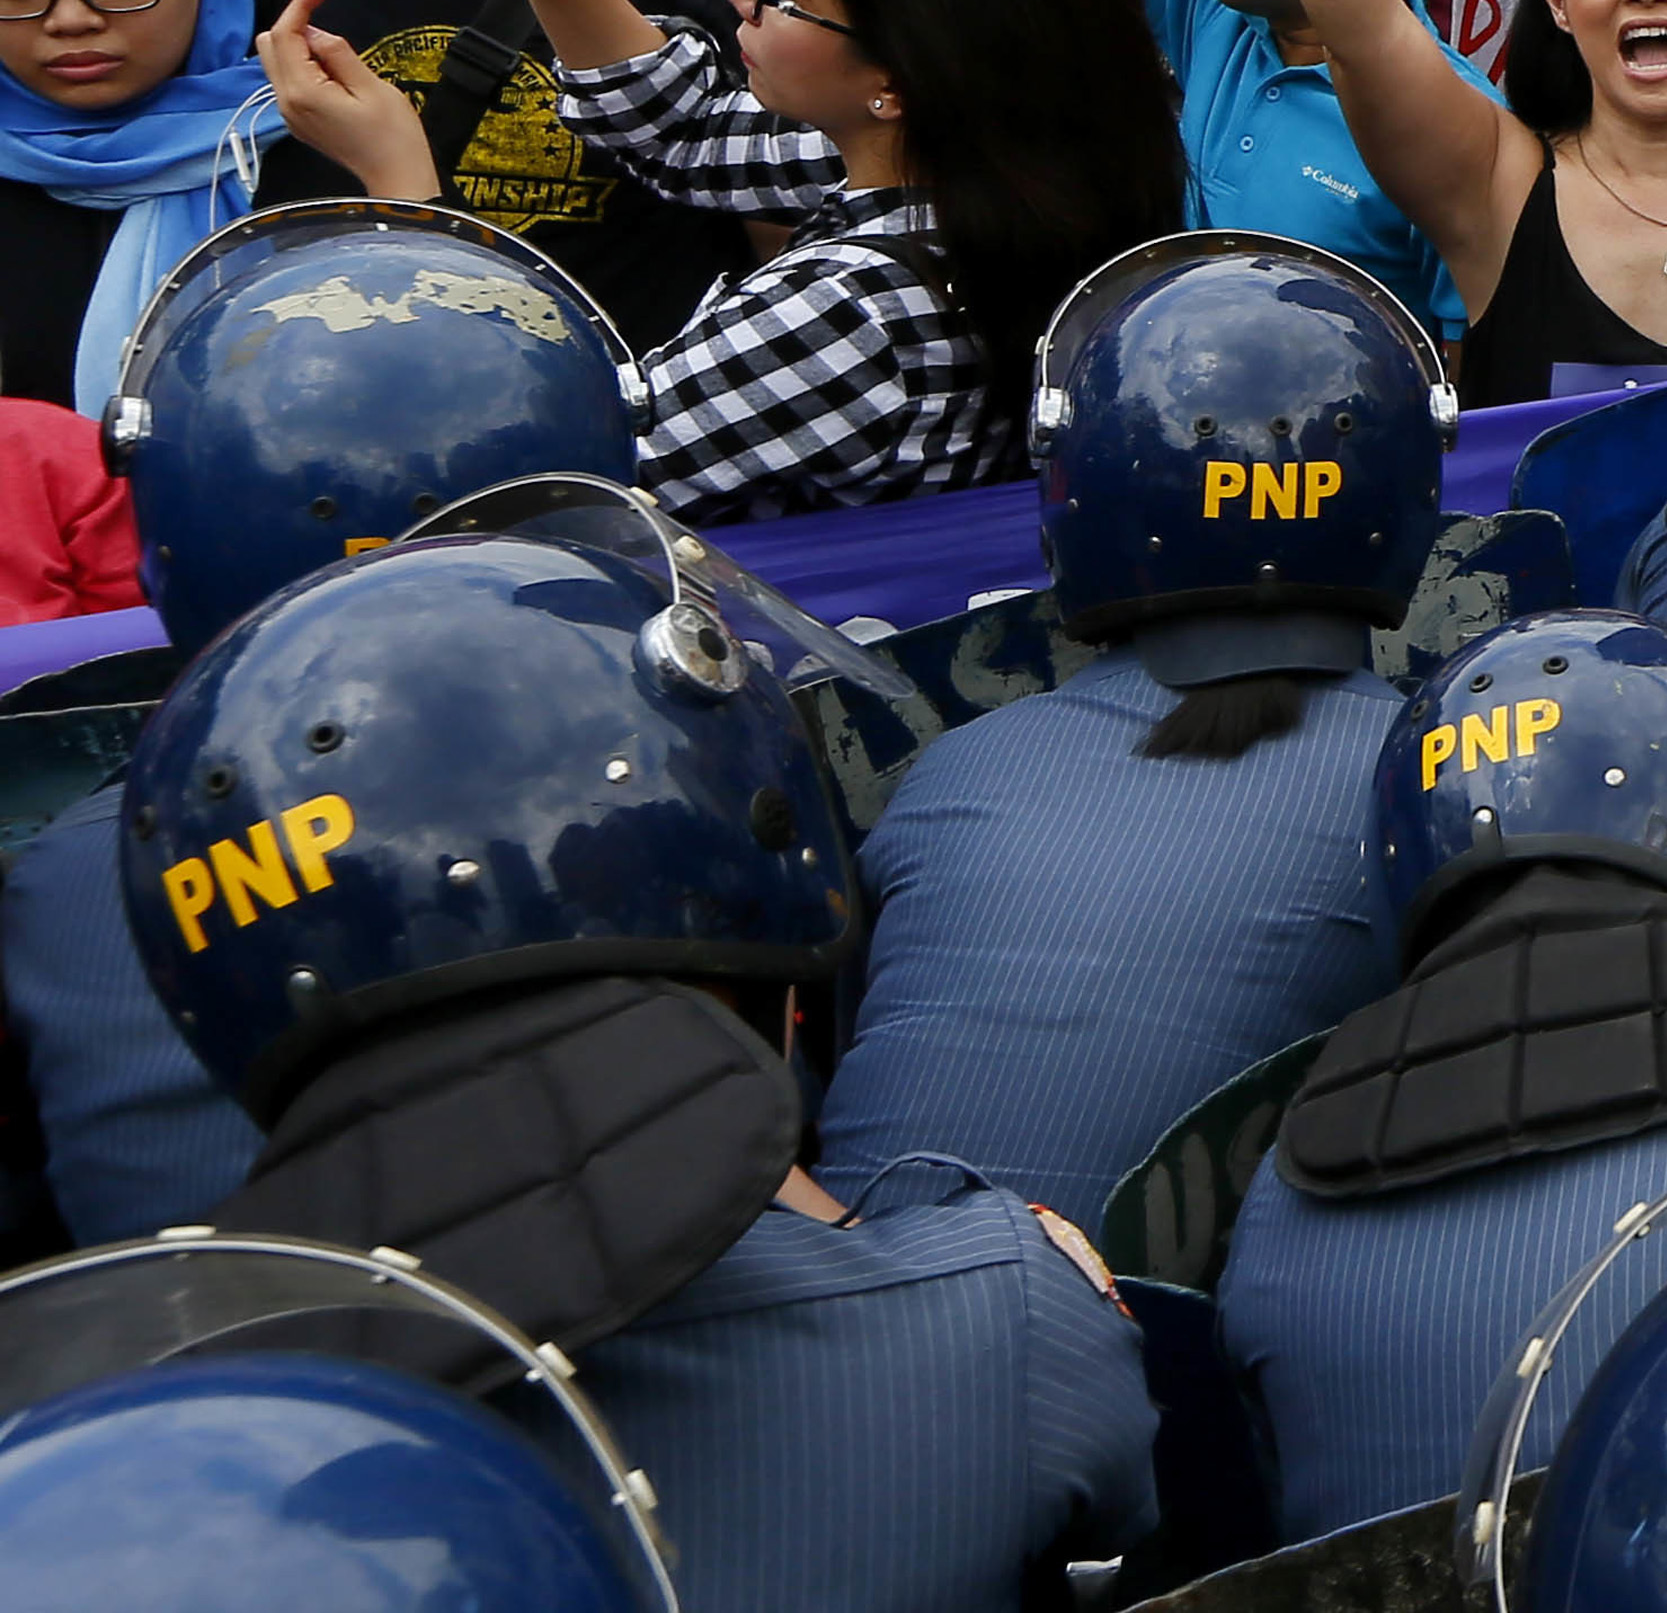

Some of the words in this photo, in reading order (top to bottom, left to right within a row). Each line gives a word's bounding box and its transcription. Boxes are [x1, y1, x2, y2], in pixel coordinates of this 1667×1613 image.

[1311, 169, 1360, 199] Columbia
[1202, 460, 1342, 520] PNP
[1420, 698, 1563, 792] PNP
[161, 793, 355, 954] PNP
